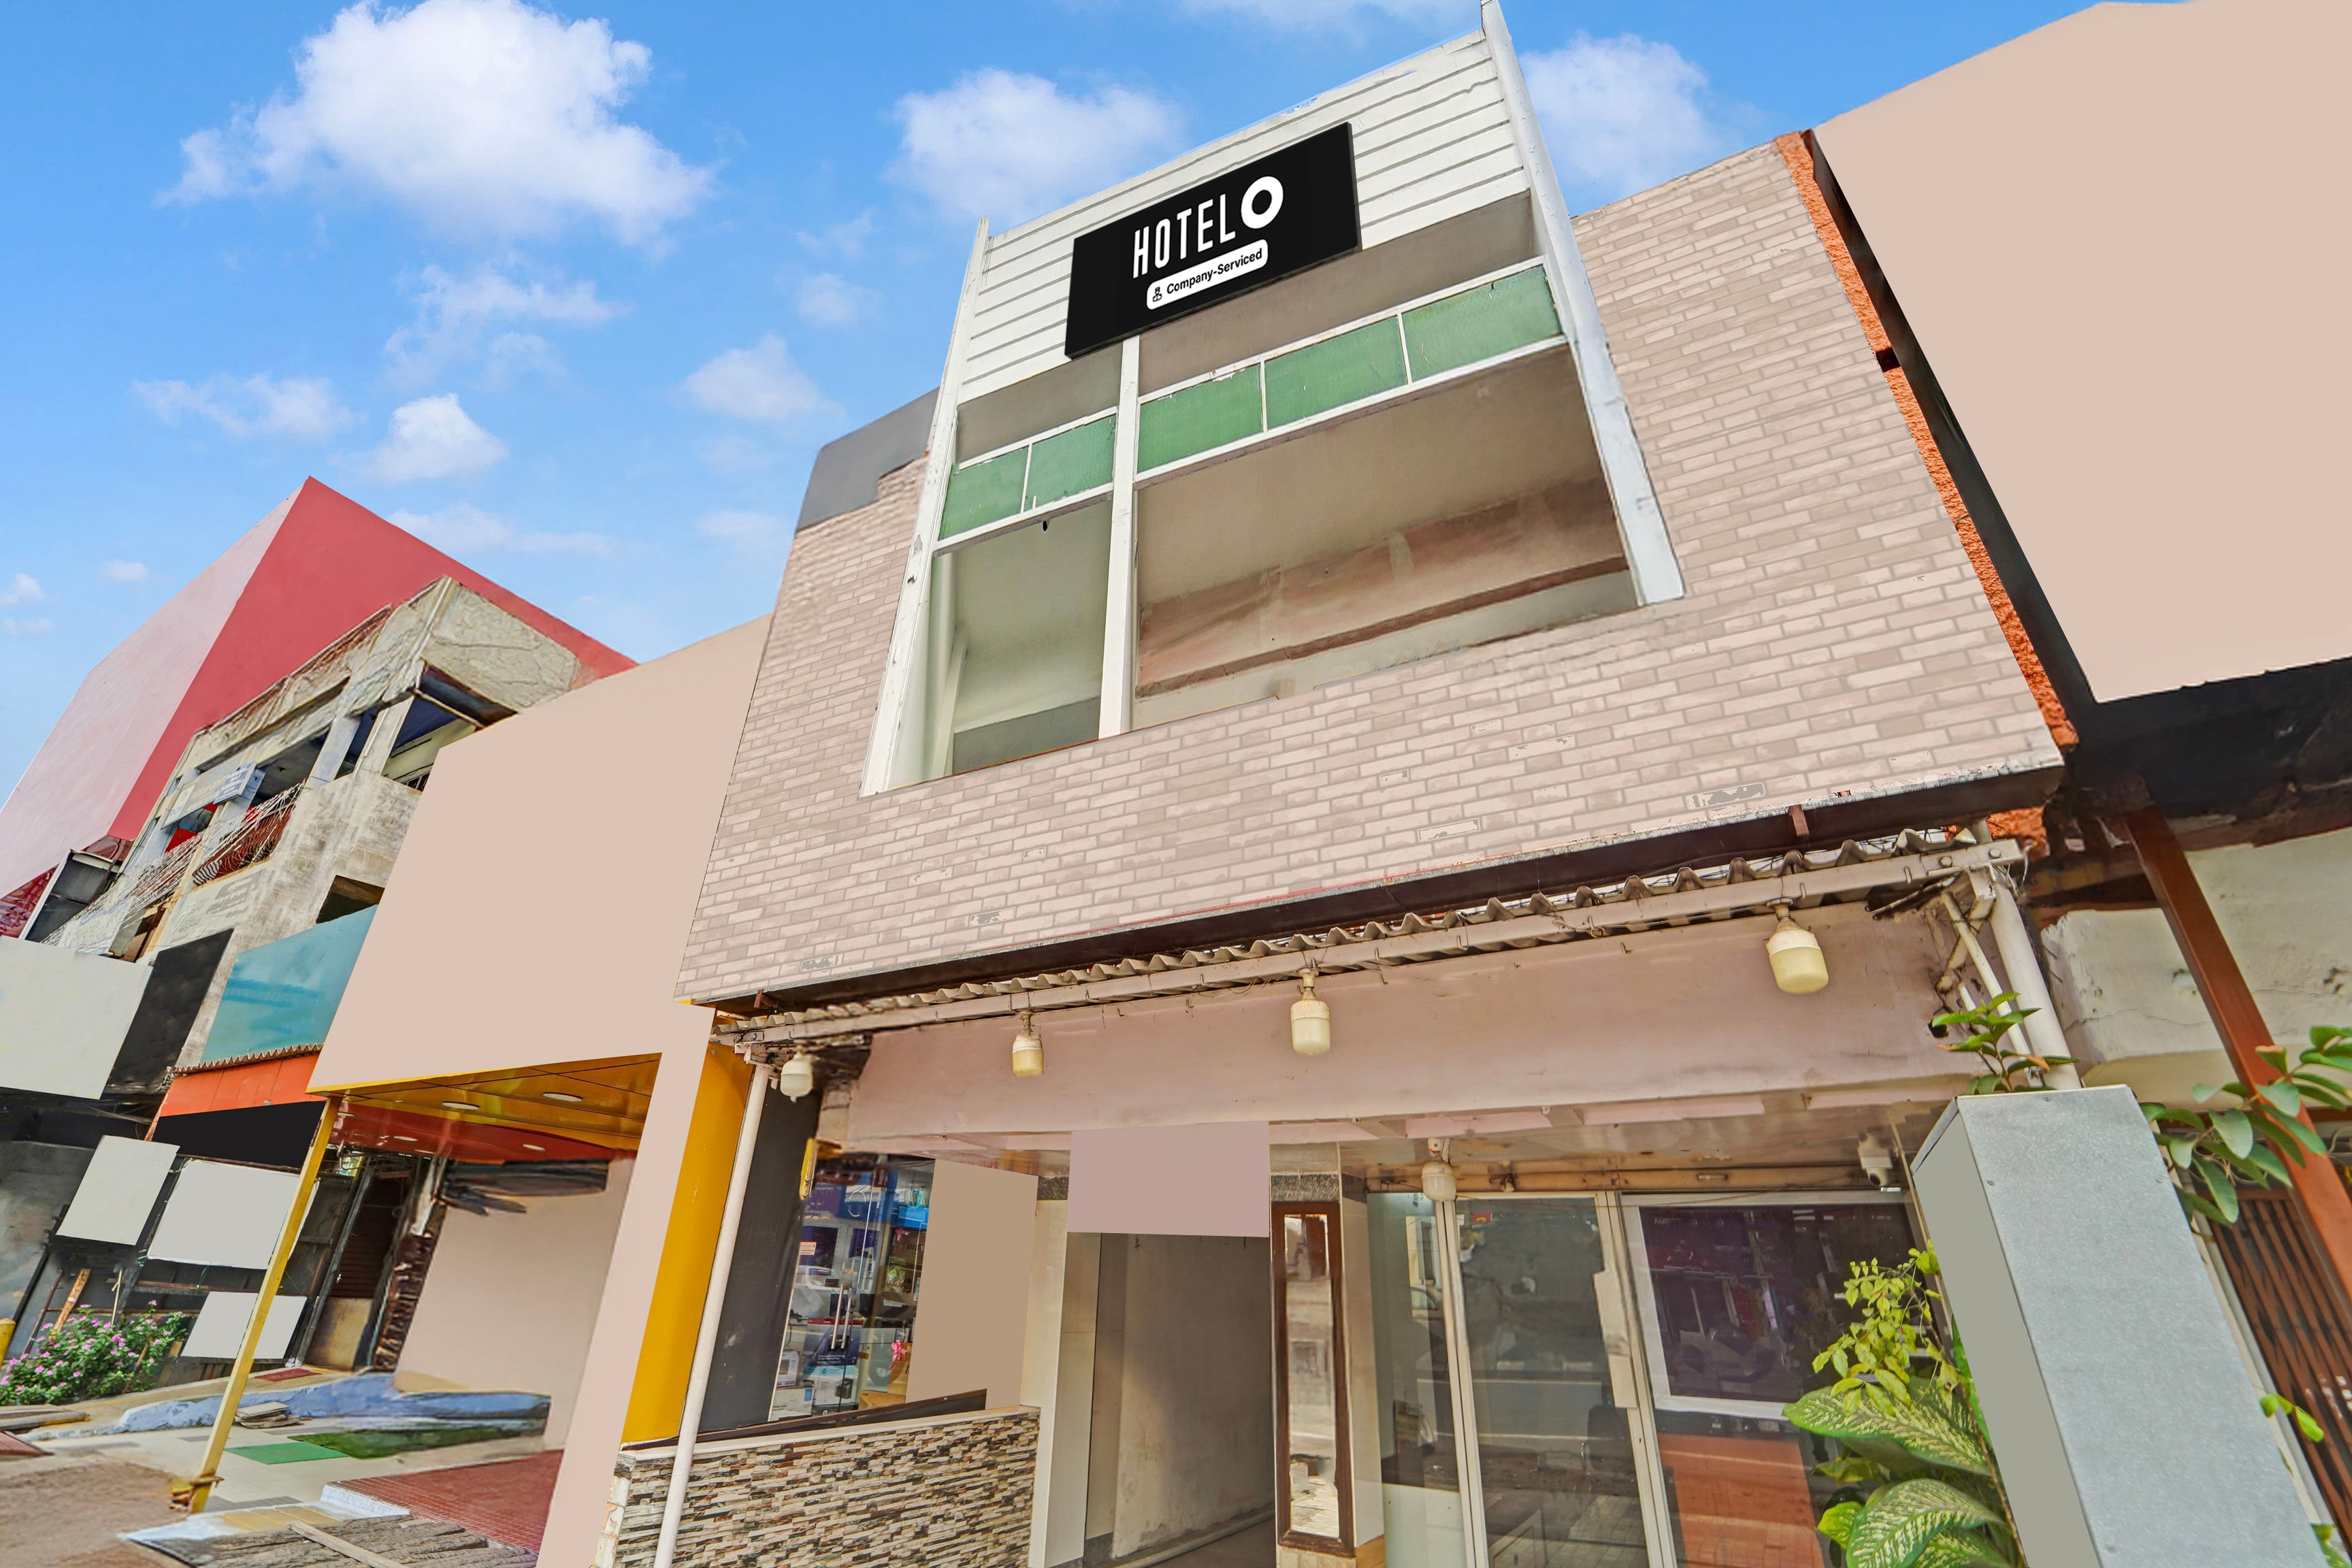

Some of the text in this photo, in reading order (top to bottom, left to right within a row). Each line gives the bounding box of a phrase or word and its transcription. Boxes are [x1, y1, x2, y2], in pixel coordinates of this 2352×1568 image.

[1132, 176, 1284, 278] HOTEL O
[1166, 248, 1262, 294] Company-Serviced
